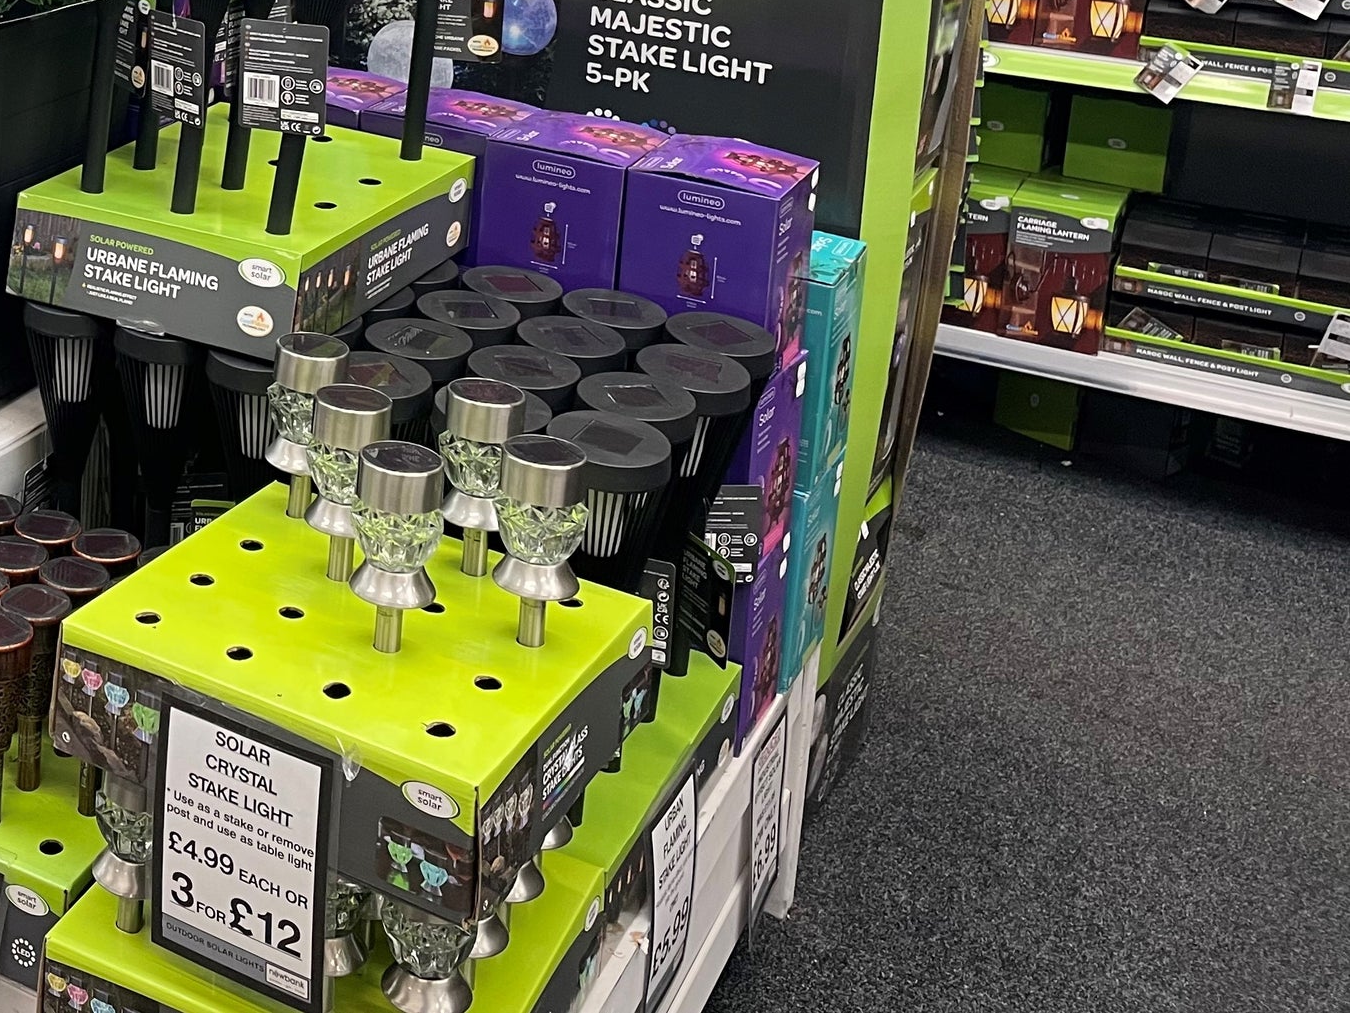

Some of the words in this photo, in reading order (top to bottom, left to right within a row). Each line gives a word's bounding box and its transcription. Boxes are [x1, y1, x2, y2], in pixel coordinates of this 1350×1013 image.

[590, 5, 731, 49] MAJESTIC
[585, 63, 650, 94] 5-PK
[588, 34, 677, 71] STAKE
[682, 52, 773, 85] LIGHT
[659, 205, 741, 226] www.lumineo-lights.com
[682, 193, 721, 207] lumineo
[90, 235, 116, 249] SOLAR
[115, 241, 154, 256] POWERED
[84, 264, 131, 288] STAKE
[134, 277, 181, 300] LIGHT
[86, 247, 147, 274] URBANE
[149, 262, 218, 291] FLAMING
[215, 731, 271, 766] SOLAR
[205, 754, 278, 795] CRYSTAL
[188, 773, 239, 806] STAKE
[244, 795, 293, 828] LIGHT
[166, 802, 190, 819] post
[193, 813, 214, 829] and
[217, 824, 236, 839] use
[240, 834, 253, 846] as
[257, 840, 284, 860] table
[288, 852, 312, 873] light
[173, 789, 194, 806] Use
[197, 801, 210, 813] as
[214, 808, 220, 818] a
[224, 811, 254, 832] stake
[257, 826, 268, 837] or
[272, 832, 314, 858] remove
[168, 831, 234, 876] £4.99
[239, 868, 280, 897] EACH
[285, 889, 308, 909] OR
[171, 872, 195, 908] 3
[196, 902, 226, 925] FOR
[229, 897, 302, 959] £12
[652, 896, 689, 978] £5.99
[269, 968, 305, 989] newbank
